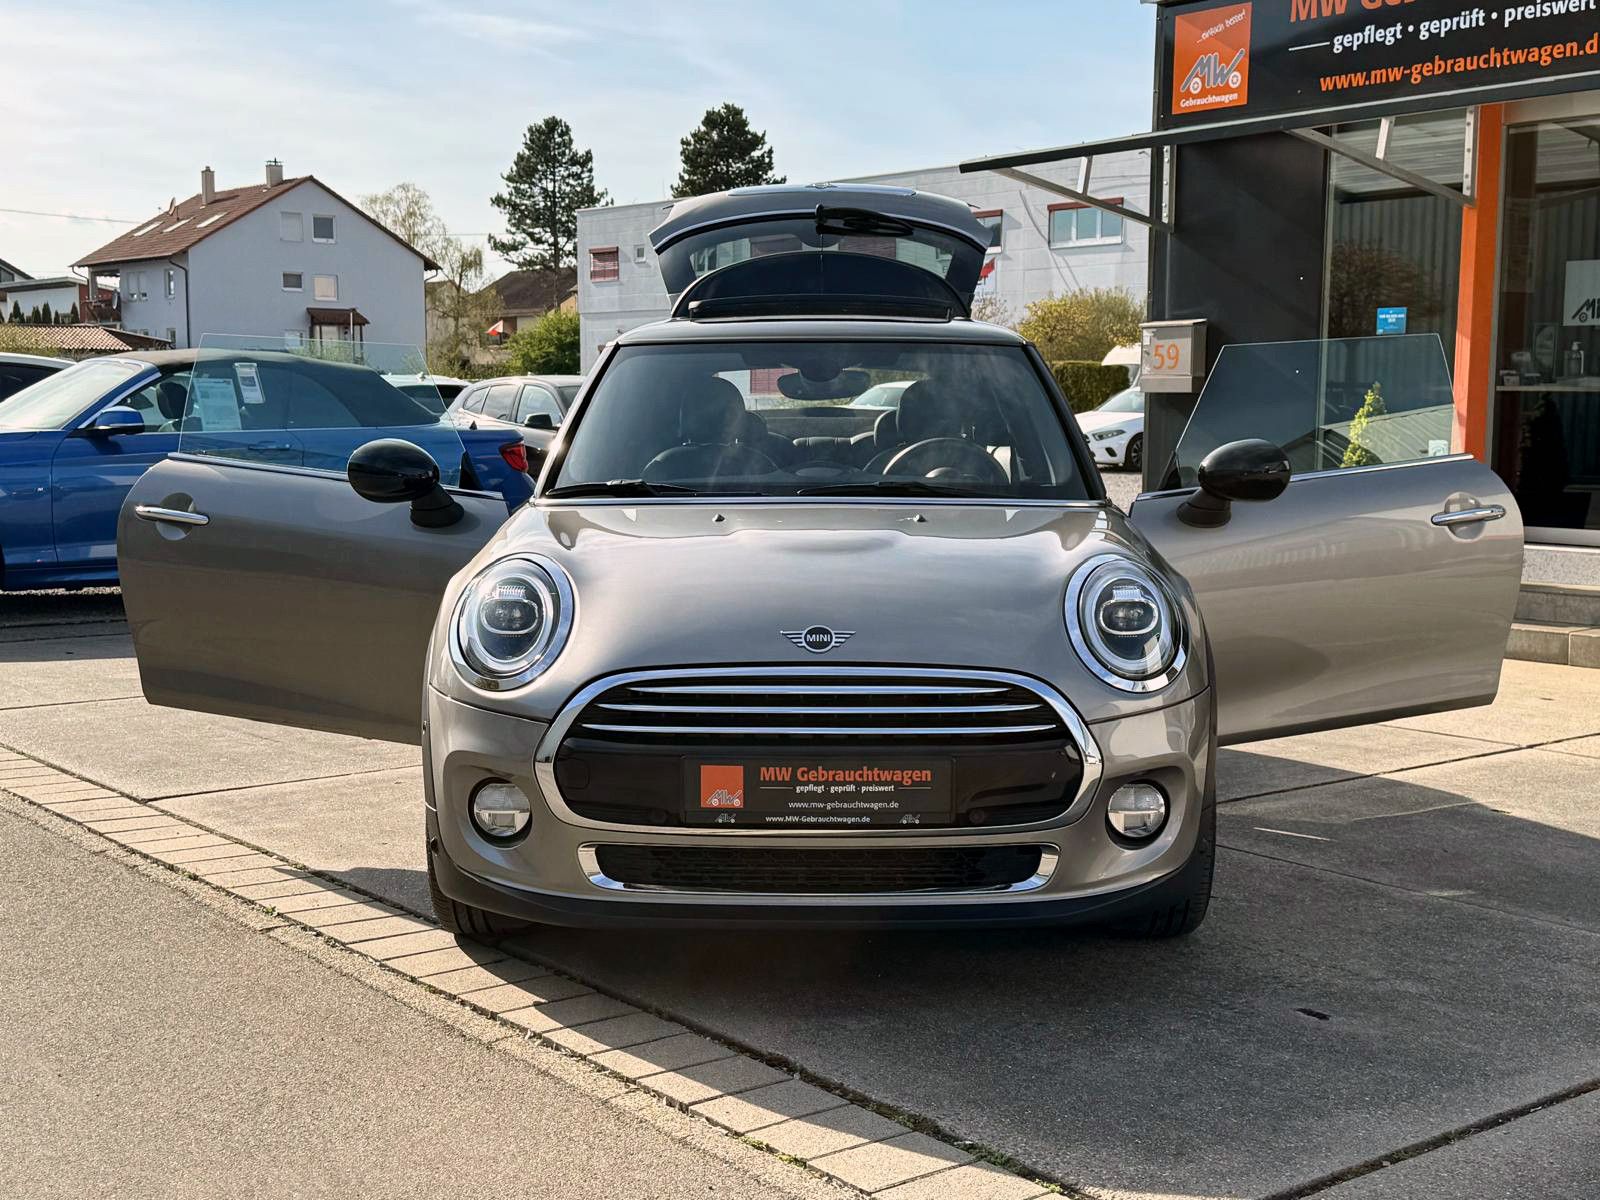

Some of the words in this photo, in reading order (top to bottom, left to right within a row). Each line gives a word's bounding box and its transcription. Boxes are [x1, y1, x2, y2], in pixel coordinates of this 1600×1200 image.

[1332, 22, 1403, 54] gepflegt
[1419, 8, 1486, 41] geprüft
[1504, 0, 1597, 28] preiswert
[1319, 31, 1600, 92] www.mw-gebrauchtwagen.d
[1181, 48, 1246, 94] MW
[1180, 92, 1239, 108] Gebrauchtwagen
[1152, 341, 1180, 370] 59
[806, 633, 832, 642] MINI
[760, 766, 792, 782] MW
[796, 766, 932, 785] Gebrauchtwagen
[795, 784, 825, 794] gepflegt
[830, 784, 856, 794] geprüft
[861, 784, 895, 793] preiswert
[788, 801, 899, 811] www.mw-gebrauchtwagen.de
[765, 815, 871, 824] www.MW-Gebrauchtwagen.de
